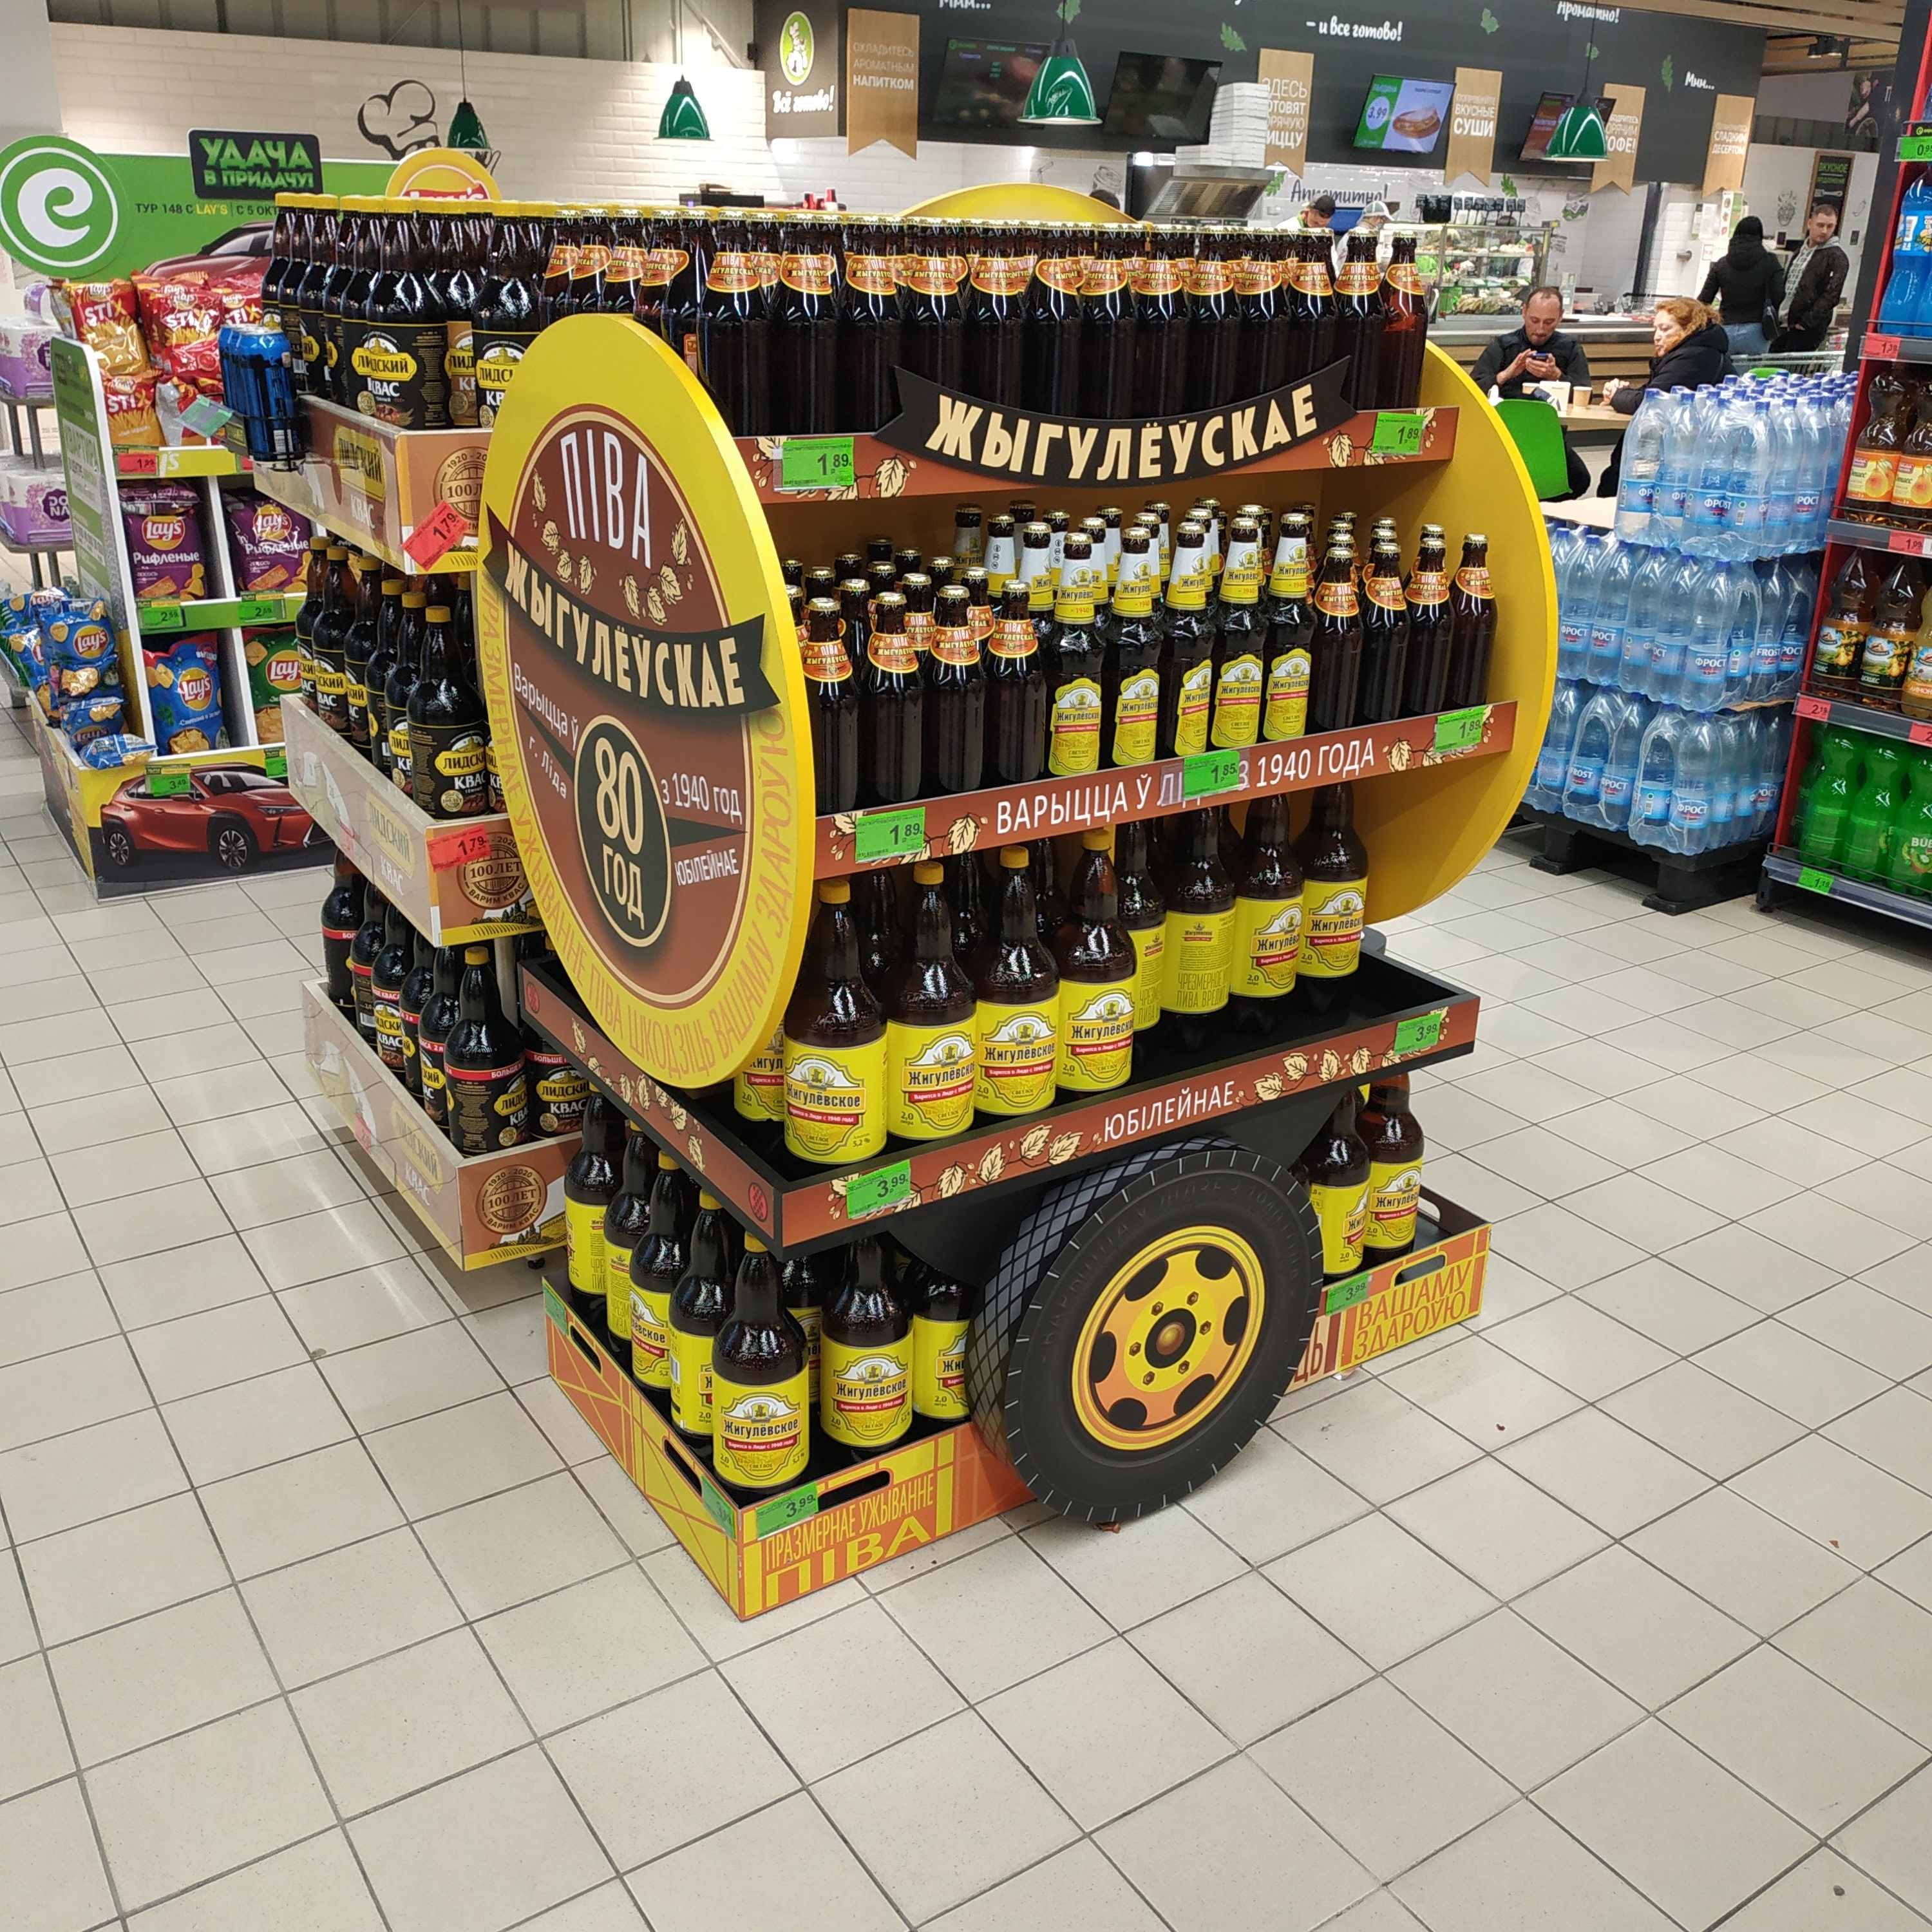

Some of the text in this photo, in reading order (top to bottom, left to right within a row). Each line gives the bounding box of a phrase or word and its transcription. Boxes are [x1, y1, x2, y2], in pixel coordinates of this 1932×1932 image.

[1319, 15, 1403, 41] и все готово!
[853, 42, 914, 57] ОХЛАДИТЕСЬ
[853, 59, 914, 73] АРОМАТНЫМ
[853, 75, 914, 90] НАПИТКОМ
[1267, 100, 1306, 115] ОТОВЯТ
[1368, 106, 1387, 119] 3.99
[1455, 103, 1495, 118] ВКУСНЫЕ
[1267, 115, 1305, 129] ОРЯЧУЮ
[1454, 118, 1494, 137] СУШИ
[1267, 130, 1303, 149] ИЦЦУ
[1605, 136, 1636, 153] ОФЕ!
[1714, 131, 1748, 143] СЛАДКИМ
[199, 138, 313, 169] УДАЧА
[204, 170, 314, 189] В ПРИДАЧУ!
[135, 204, 158, 213] ТУР
[162, 204, 182, 214] 148
[196, 204, 227, 214] LAY'S
[247, 205, 254, 215] 5
[85, 299, 128, 323] STIX
[108, 389, 149, 413] STIX
[925, 383, 1317, 481] ЖЫГУЛЁЎСКАЕ
[339, 437, 383, 484] ЛИДСКИЙ
[447, 453, 468, 470] 1920
[560, 428, 651, 569] ПІВА
[350, 493, 375, 529] КВАС
[146, 520, 182, 541] Lay's
[133, 551, 200, 565] Рифленые
[504, 538, 745, 707] ЖЫГУЛЁЎСКАЕ
[1005, 621, 1021, 632] ПІВА
[76, 630, 108, 656] Lay's
[1695, 657, 1726, 668] ФРОСТ
[181, 675, 211, 701] Lay's
[514, 662, 578, 751] Варыцца ў
[443, 754, 486, 769] ЛИДСКИ
[454, 772, 486, 789] КВАС
[997, 782, 1128, 835] ВАРЫЦЦА
[1136, 773, 1151, 810] Ў
[1256, 749, 1311, 787] 1940
[1318, 738, 1374, 778] ГОДА
[594, 737, 643, 855] 80
[672, 772, 709, 811] 1940
[1677, 802, 1707, 815] ФРОСТ
[481, 583, 524, 803] ПРАЗМЕРНАЕ
[588, 963, 623, 1039] ПІВА
[627, 1004, 714, 1079] ШКОДЗІЦЬ
[712, 925, 773, 1064] ВАШАМУ
[755, 706, 791, 938] ЗДАРОЎЮ
[497, 837, 517, 848] 2020
[381, 857, 404, 896] КВАС
[674, 848, 739, 886] ЮБІЛЕЙНАЕ
[468, 883, 524, 904] ВАРИМ КВАС
[602, 844, 645, 930] ГОД
[1301, 953, 1312, 961] 2,0
[1178, 971, 1222, 990] ЧРЕЗМЕРНОЕ
[1177, 990, 1198, 1008] ПИВА
[985, 1042, 1055, 1063] Жигулёвское
[491, 1066, 518, 1079] БОЛЬШЕ
[1063, 1063, 1075, 1072] 2,0
[786, 1082, 860, 1108] Жигулёвское
[978, 1085, 989, 1094] 2,0
[551, 1099, 587, 1113] КВАС
[1104, 1080, 1233, 1142] ЮБІЛЕЙНАЕ
[404, 1162, 430, 1206] КВАС
[488, 1168, 533, 1187] 1920 2020
[486, 1208, 538, 1229] ВАРИМ КВАС
[1359, 1261, 1472, 1331] ВАШАМУ
[1354, 1291, 1466, 1361] ЗДАРОЎЮ
[837, 1378, 906, 1400] Жигулёвское
[724, 1419, 799, 1439] Жигулёвское
[766, 1505, 855, 1571] ПРАЗМЕРНАЕ
[766, 1516, 931, 1607] ПІВА
